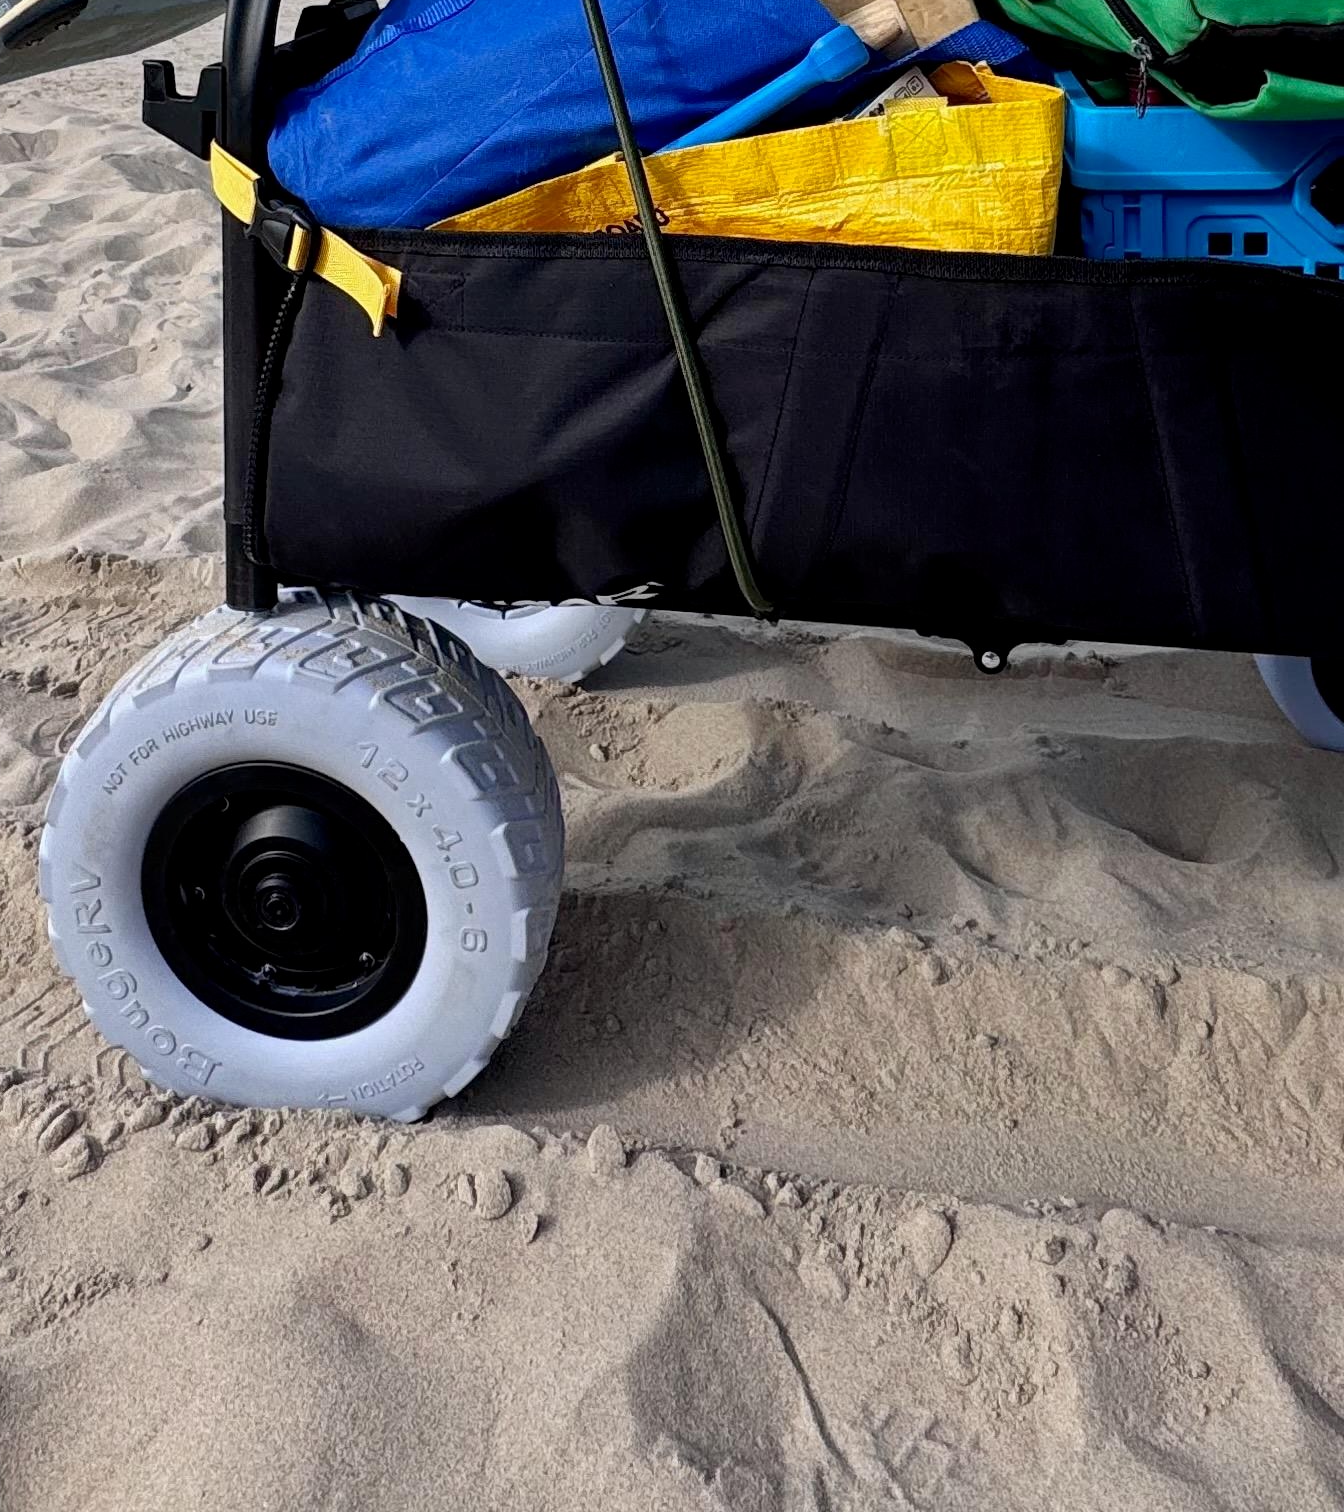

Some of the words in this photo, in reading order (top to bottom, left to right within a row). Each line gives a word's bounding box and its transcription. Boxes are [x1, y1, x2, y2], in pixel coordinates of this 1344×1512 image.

[102, 762, 129, 796] NOT
[128, 738, 161, 767] FOR
[162, 709, 235, 744] HIGHWAY
[243, 708, 279, 727] USE
[357, 741, 410, 791] 12
[68, 862, 224, 1088] BougeRV
